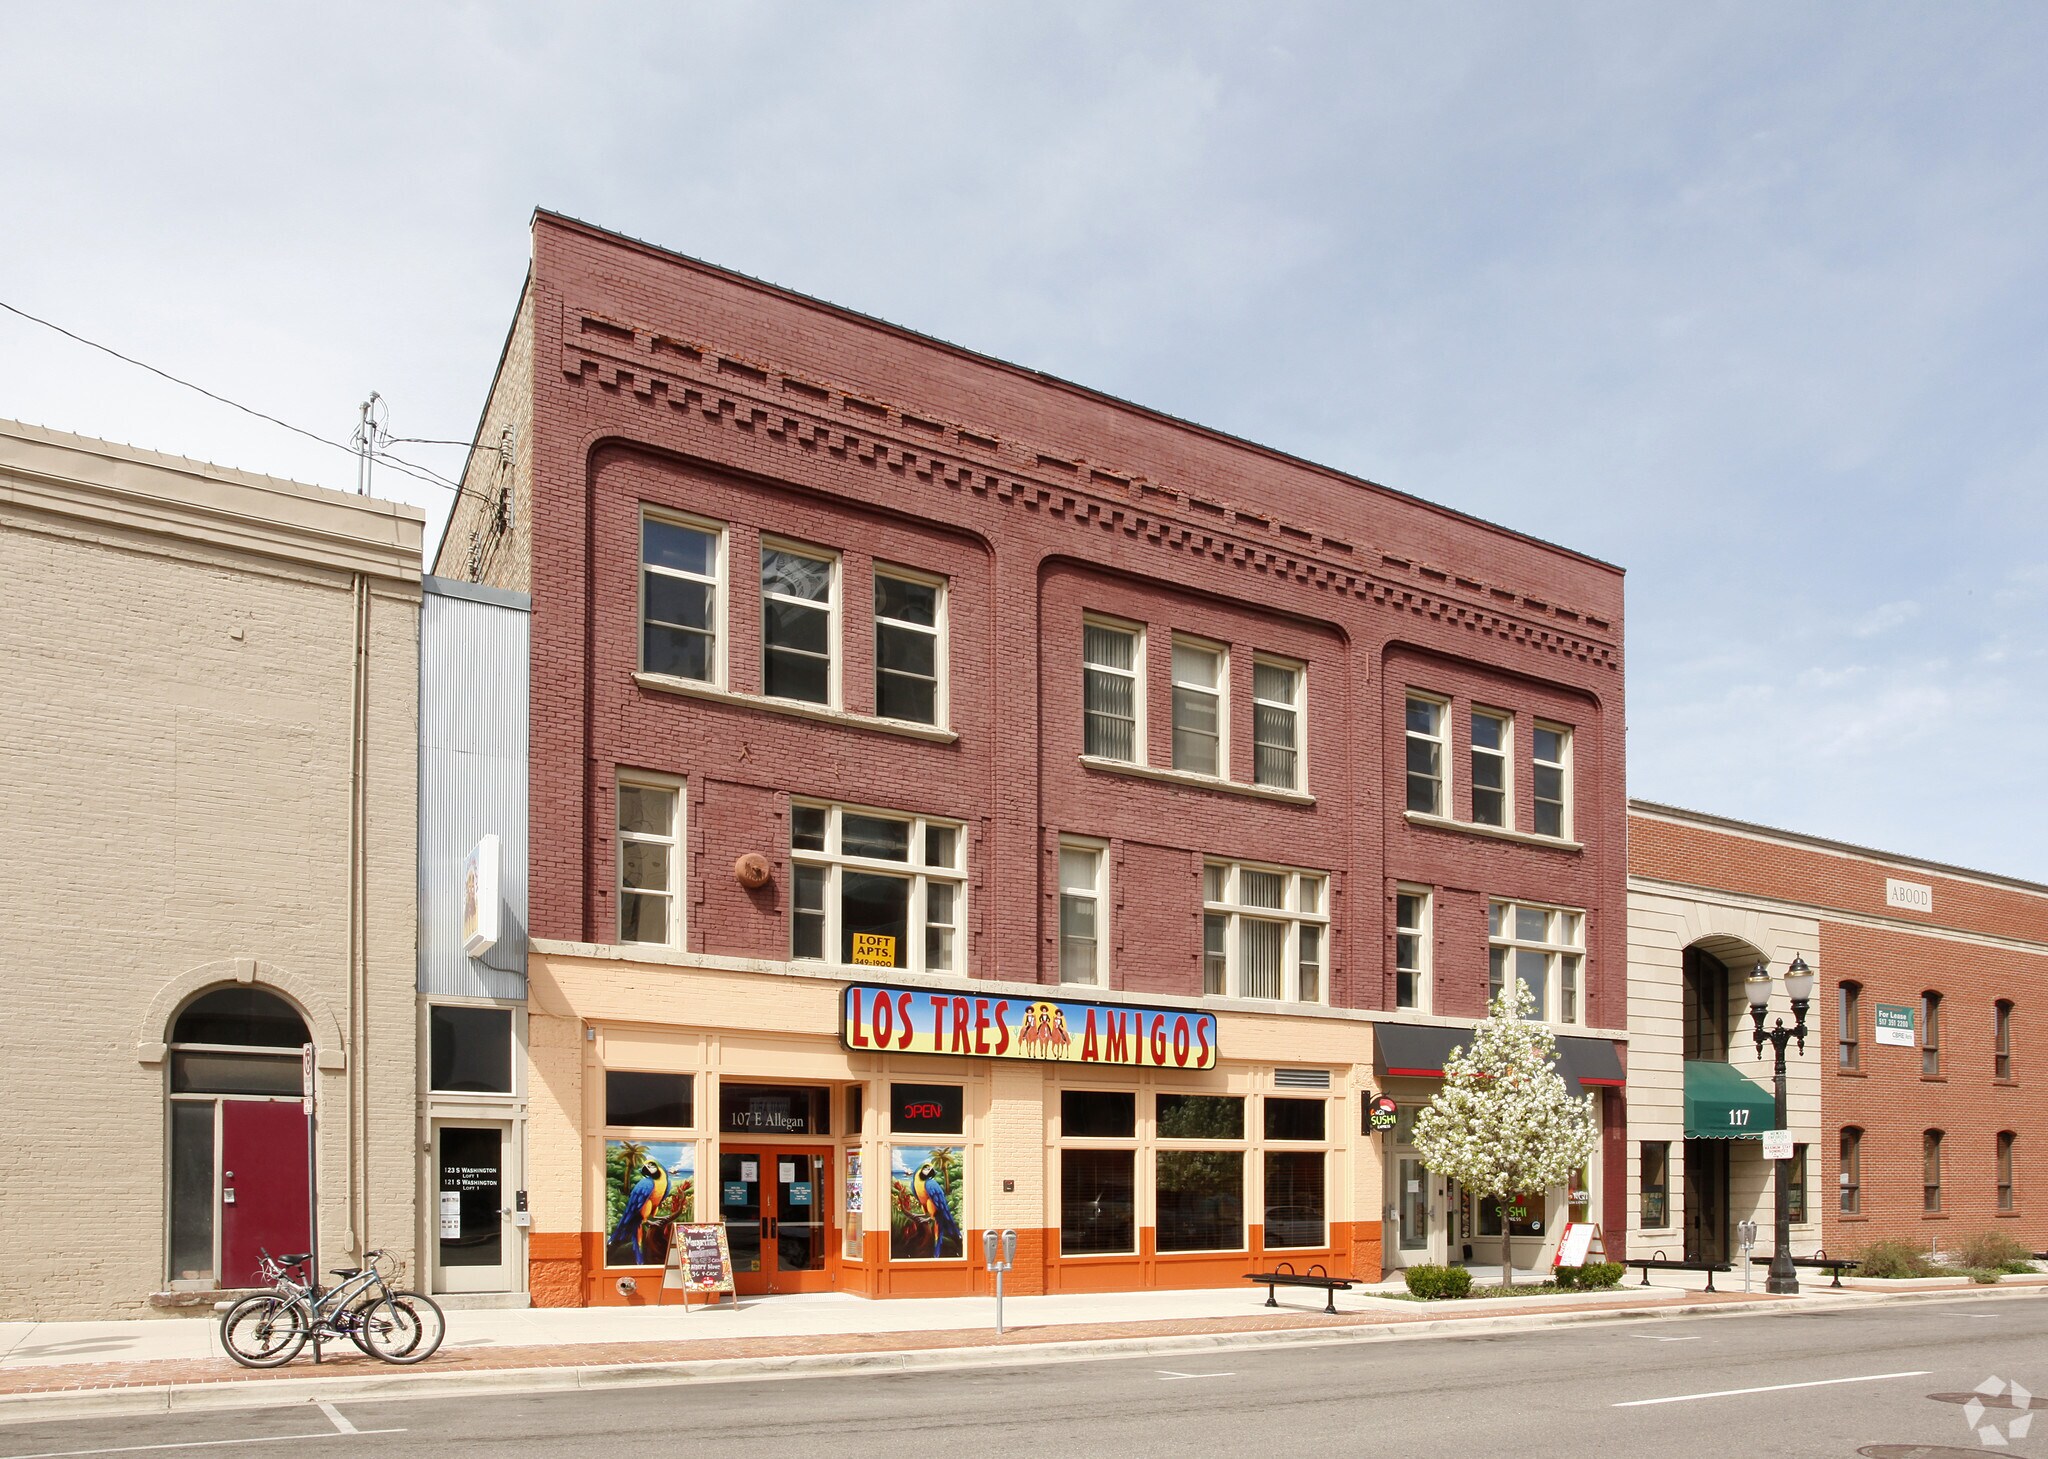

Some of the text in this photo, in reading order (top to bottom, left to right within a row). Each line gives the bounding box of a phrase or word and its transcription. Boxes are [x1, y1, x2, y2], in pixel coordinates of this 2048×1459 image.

[1892, 887, 1928, 905] ABOOD
[859, 935, 890, 946] LOFT
[857, 946, 892, 958] APTS.
[1878, 1010, 1907, 1020] For Lease
[851, 988, 1211, 1069] LOS TRES AMIGOS
[904, 1104, 941, 1119] OPEN
[1728, 1109, 1750, 1126] 117
[731, 1112, 804, 1130] 107 E Allegan
[1371, 1115, 1396, 1125] SUSHI
[1495, 1206, 1527, 1217] SSHI
